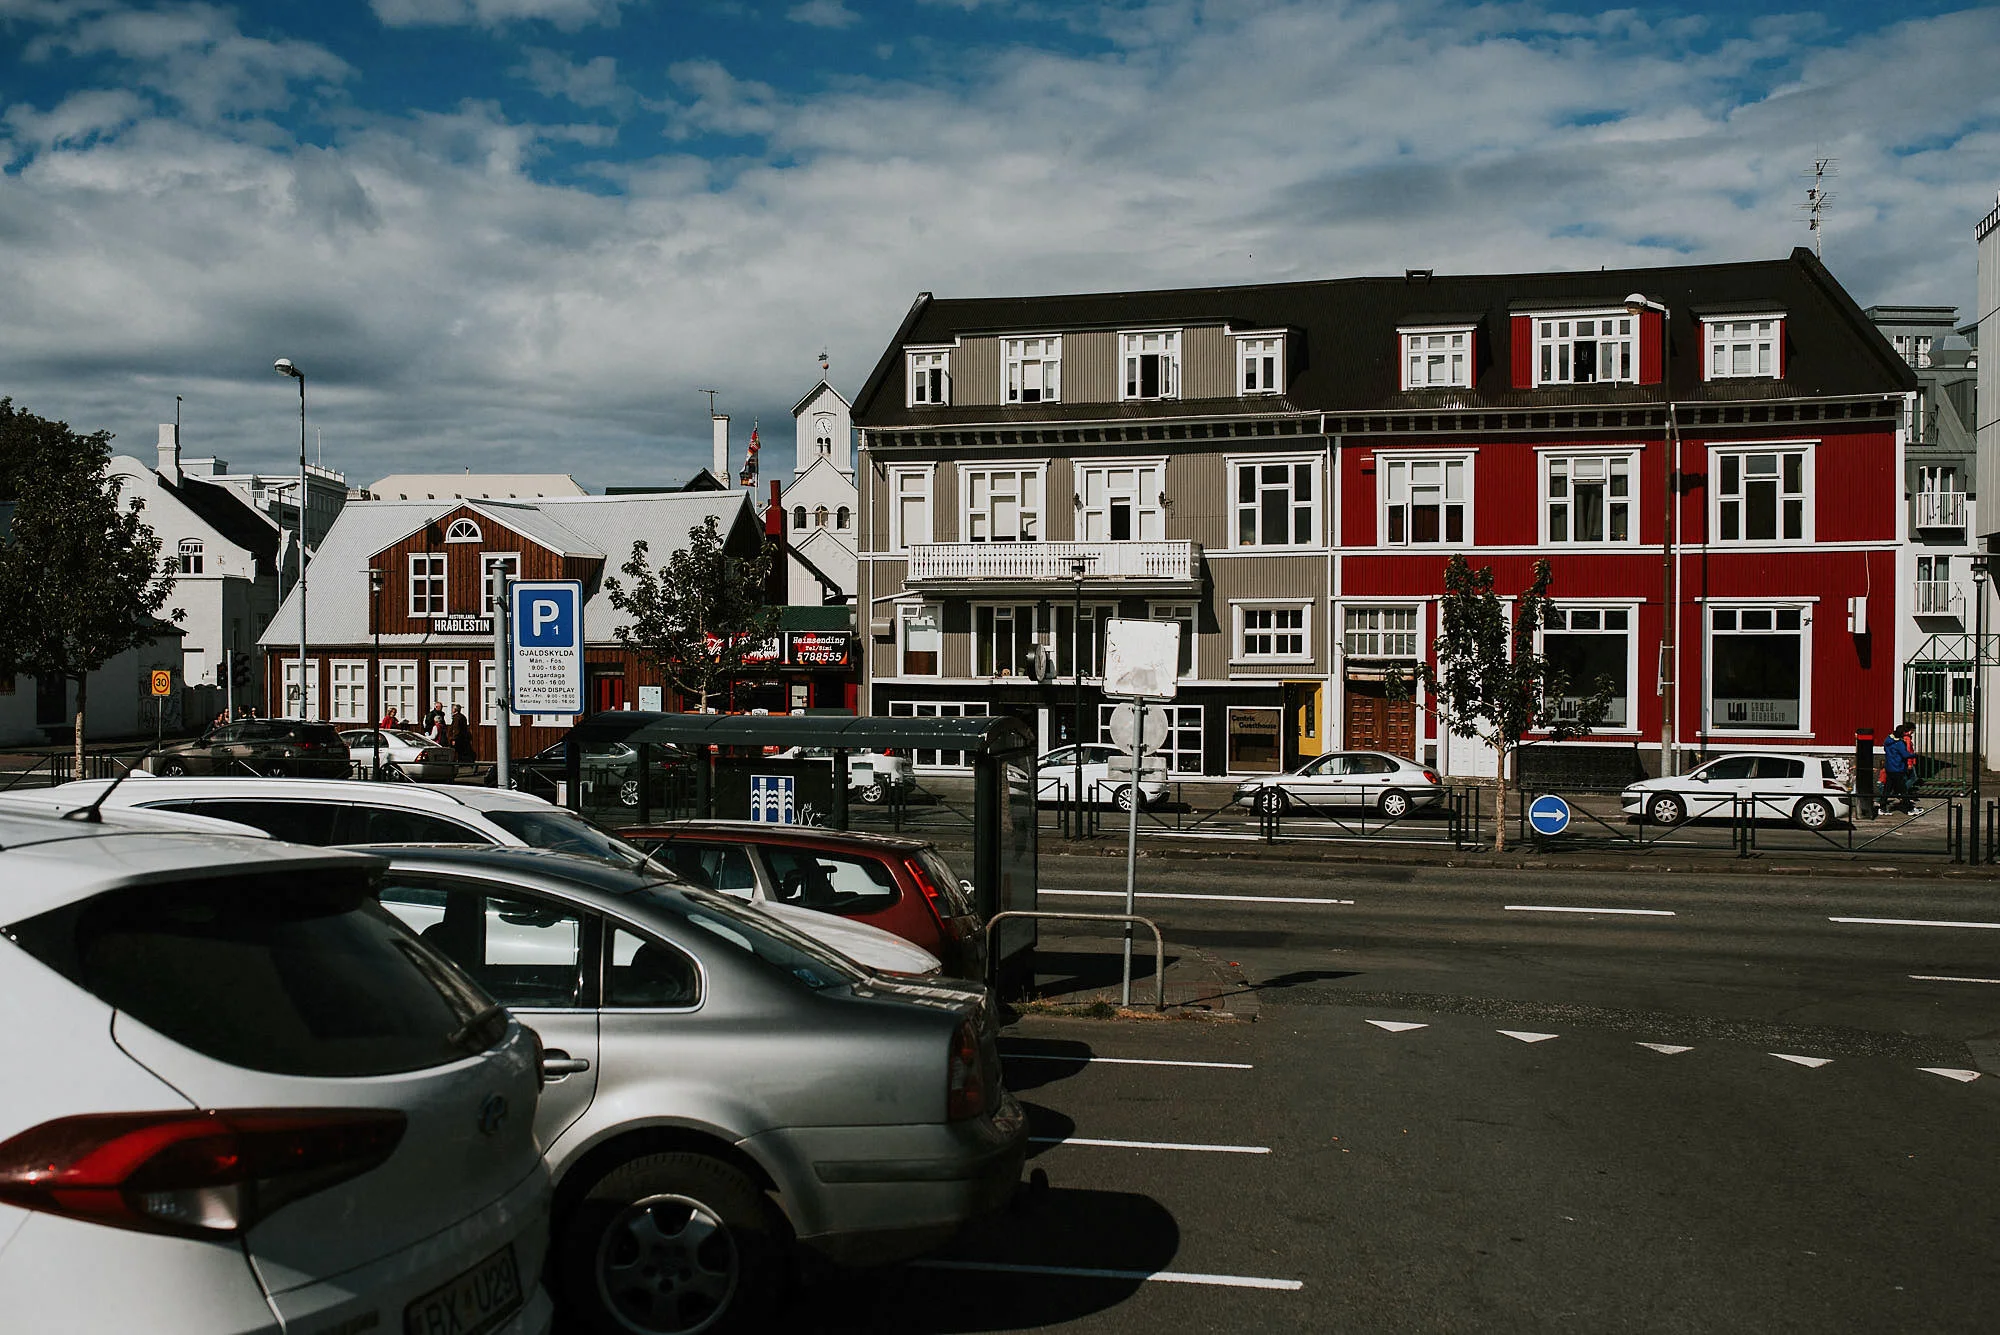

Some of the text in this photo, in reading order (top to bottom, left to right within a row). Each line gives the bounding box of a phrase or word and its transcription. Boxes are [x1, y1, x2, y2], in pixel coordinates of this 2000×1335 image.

[533, 599, 560, 637] P
[434, 619, 490, 632] HRAÐLESTIN
[552, 624, 559, 636] 1
[792, 635, 845, 646] Heimsending
[519, 649, 574, 657] GJALDSKYLDA
[796, 651, 842, 662] 5788555
[155, 678, 167, 687] 30
